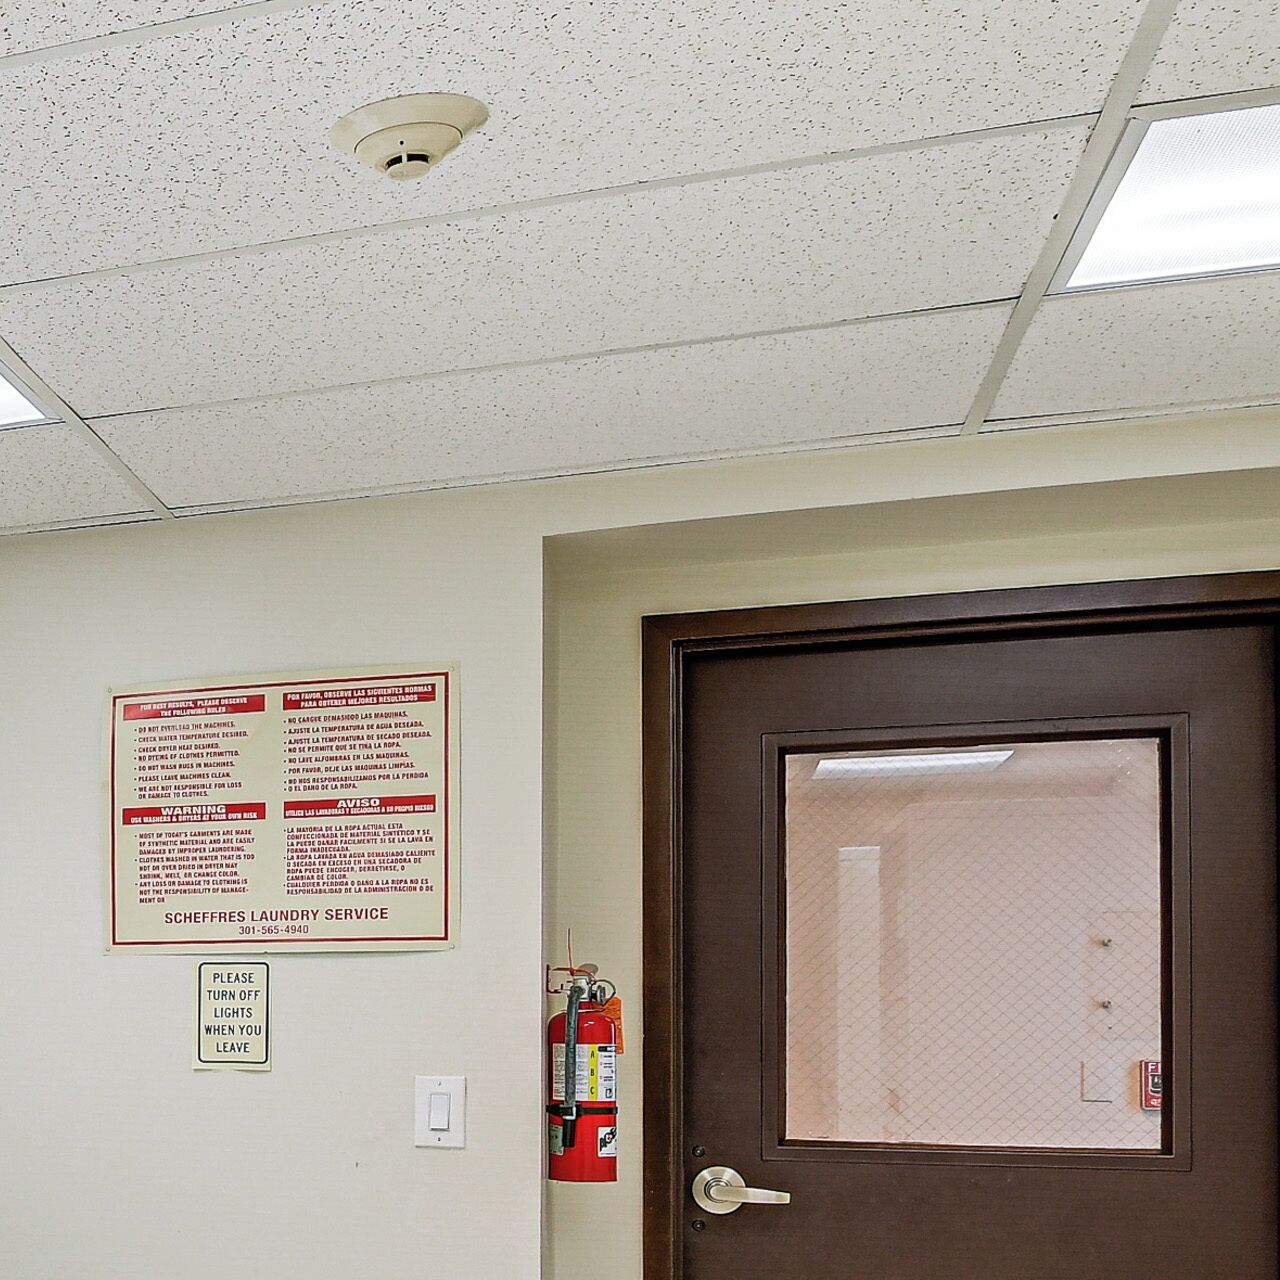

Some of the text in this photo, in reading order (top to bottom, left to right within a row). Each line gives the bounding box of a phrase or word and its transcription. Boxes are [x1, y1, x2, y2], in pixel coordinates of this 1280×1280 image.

[337, 799, 380, 808] AVISO
[160, 805, 226, 815] WARNING
[165, 907, 389, 924] SCHEFFRES LAUNDRY SERVICE
[238, 925, 309, 935] 301-565-4940
[213, 973, 254, 983] PLEASE
[207, 990, 260, 1000] TURN OFF
[214, 1007, 253, 1018] LIGHTS
[204, 1025, 261, 1035] WHEN YOU
[216, 1042, 250, 1053] LEAVE
[591, 1050, 595, 1058] A
[590, 1087, 595, 1095] C
